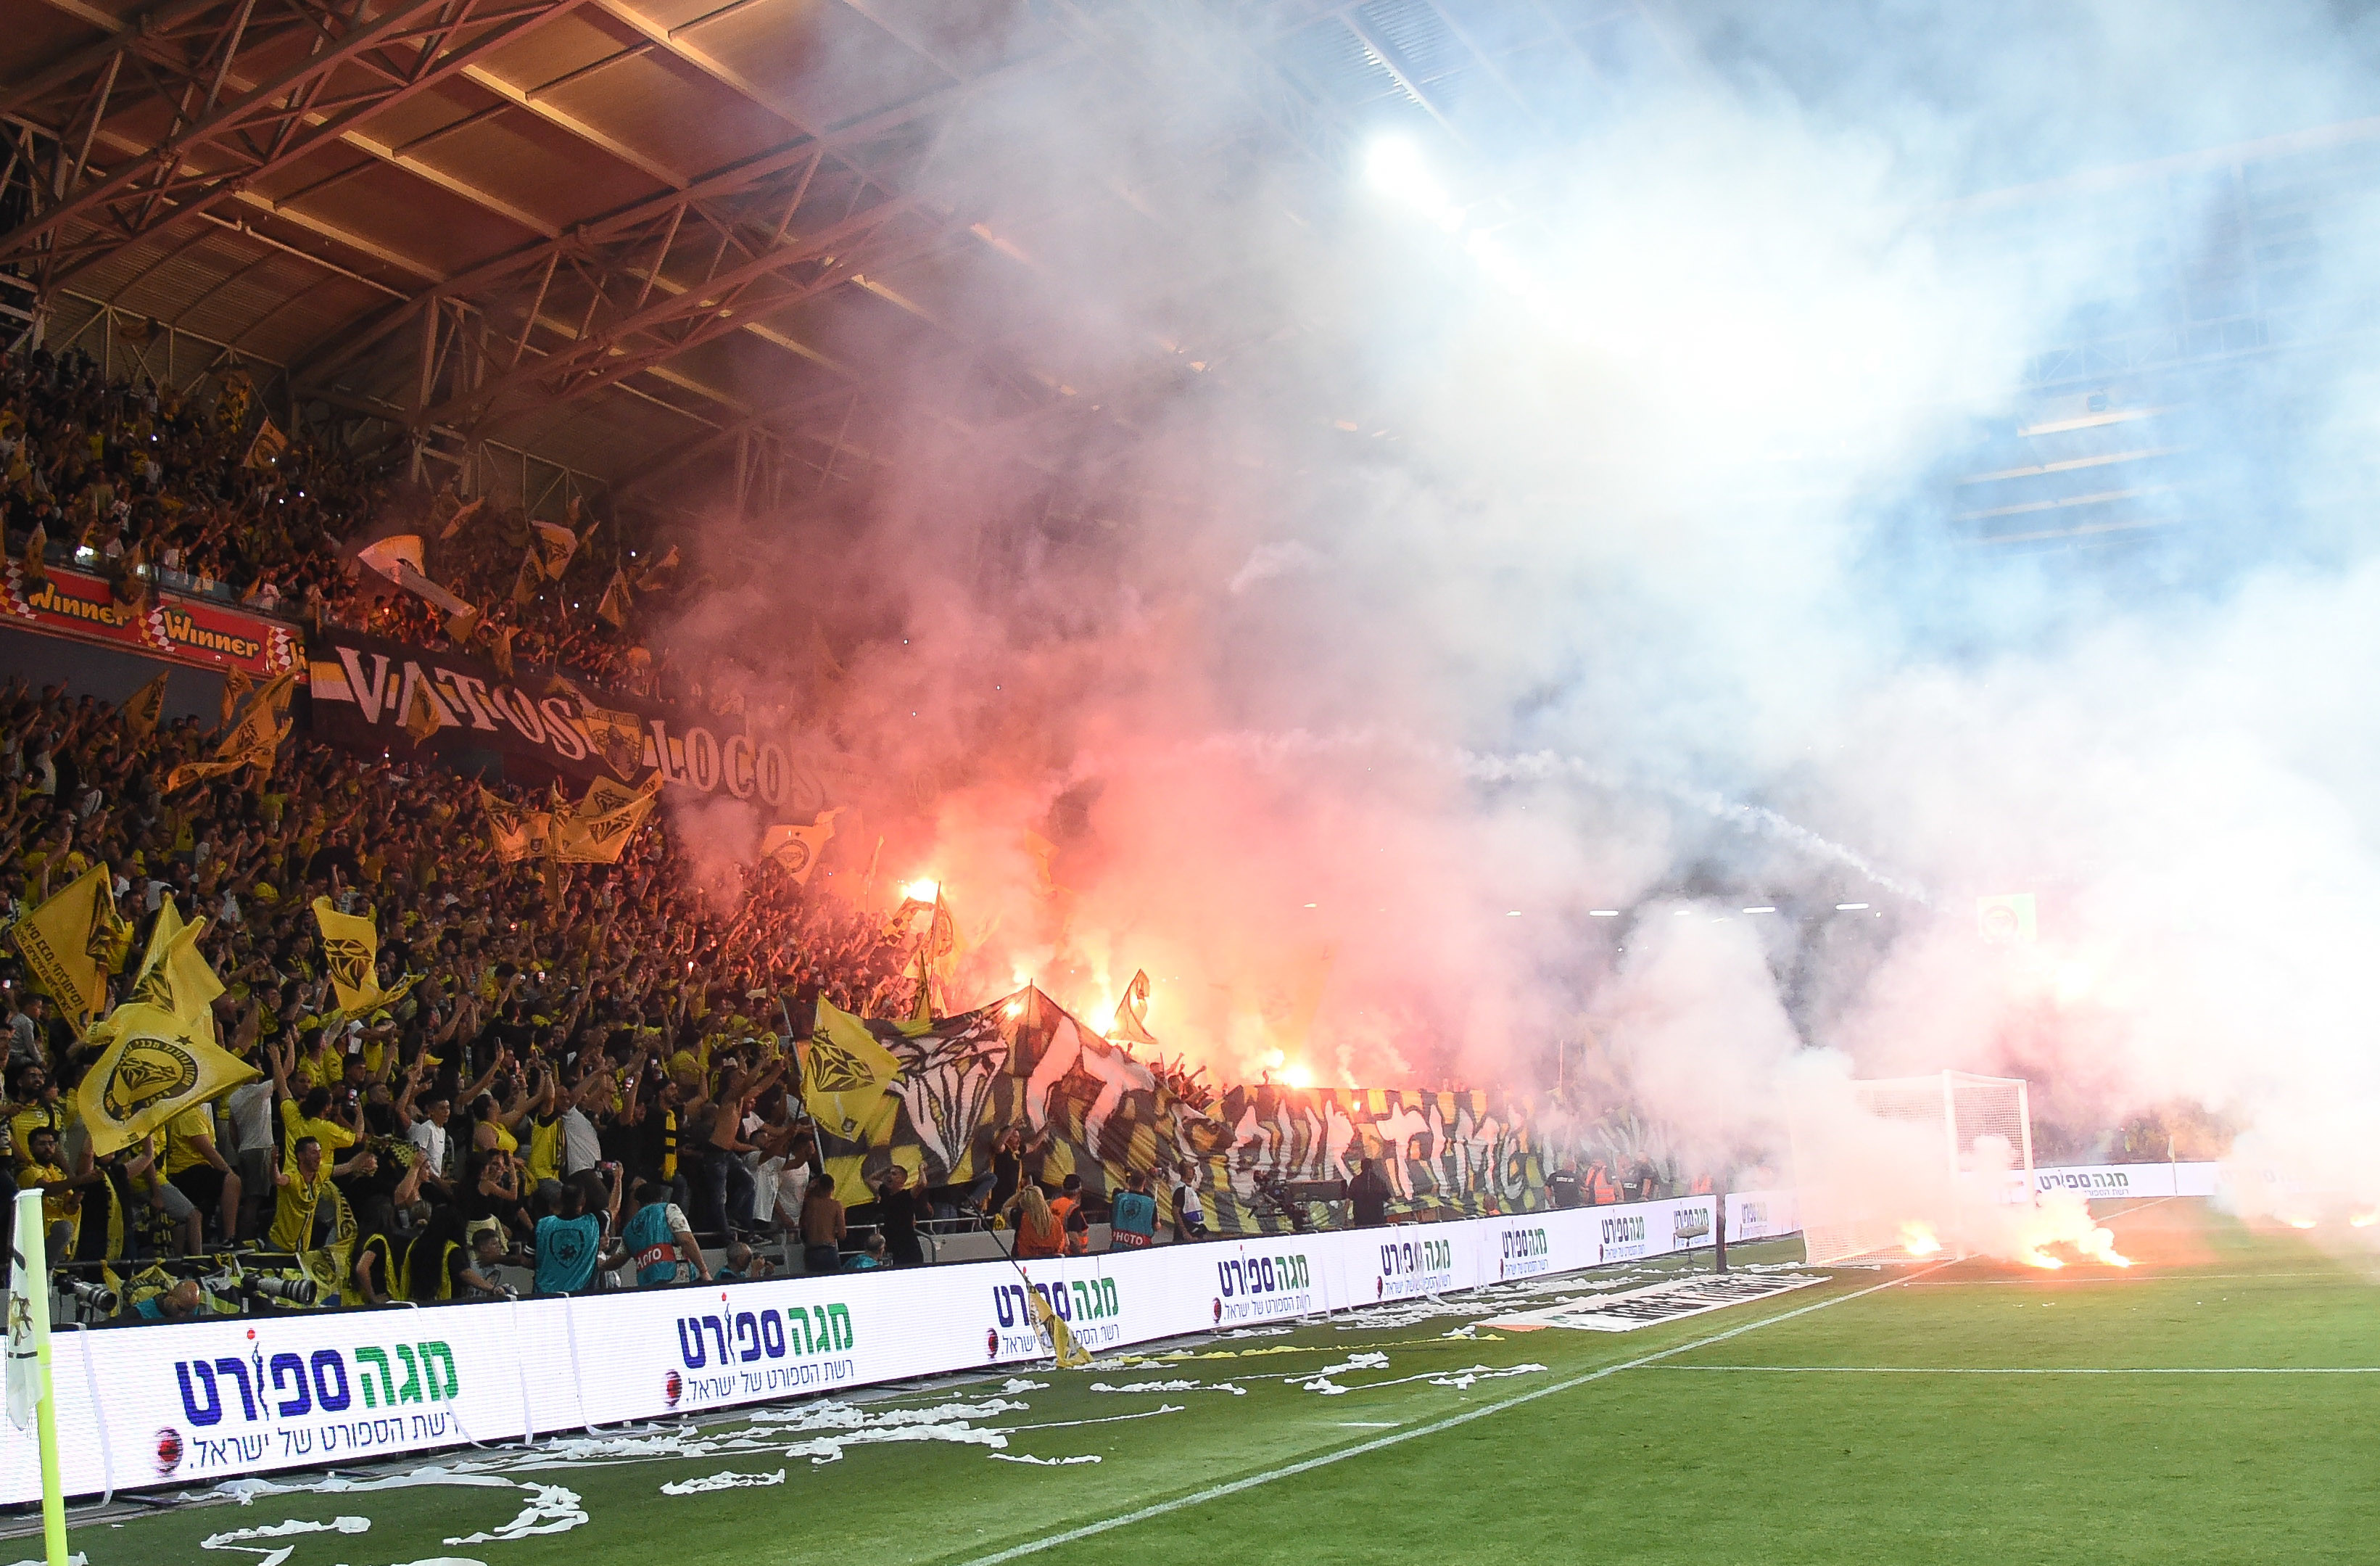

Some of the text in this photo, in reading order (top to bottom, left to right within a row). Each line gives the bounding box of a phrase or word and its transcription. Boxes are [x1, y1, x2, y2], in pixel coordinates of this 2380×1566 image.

[163, 611, 260, 657] Winner
[336, 646, 825, 811] VATOS LOCOS
[135, 1040, 161, 1049] מכבי
[2039, 1172, 2129, 1190] מגה ספורט
[1502, 1228, 1548, 1258] מגה ספורט
[1601, 1216, 1645, 1244] מגה ספורט
[1424, 1240, 1450, 1271] מגה
[1218, 1253, 1309, 1297] מגה ספורט
[1072, 1277, 1118, 1321] מגה
[1252, 1299, 1263, 1315] של
[677, 1303, 853, 1369] מגה ספורט
[1001, 1335, 1036, 1355] ישראל.
[175, 1341, 458, 1427] מגה ספורט
[686, 1360, 854, 1403] רשת הספורט של ישראל.
[191, 1433, 269, 1469] ישראל.
[278, 1427, 312, 1456] של
[321, 1417, 404, 1451] הספורט
